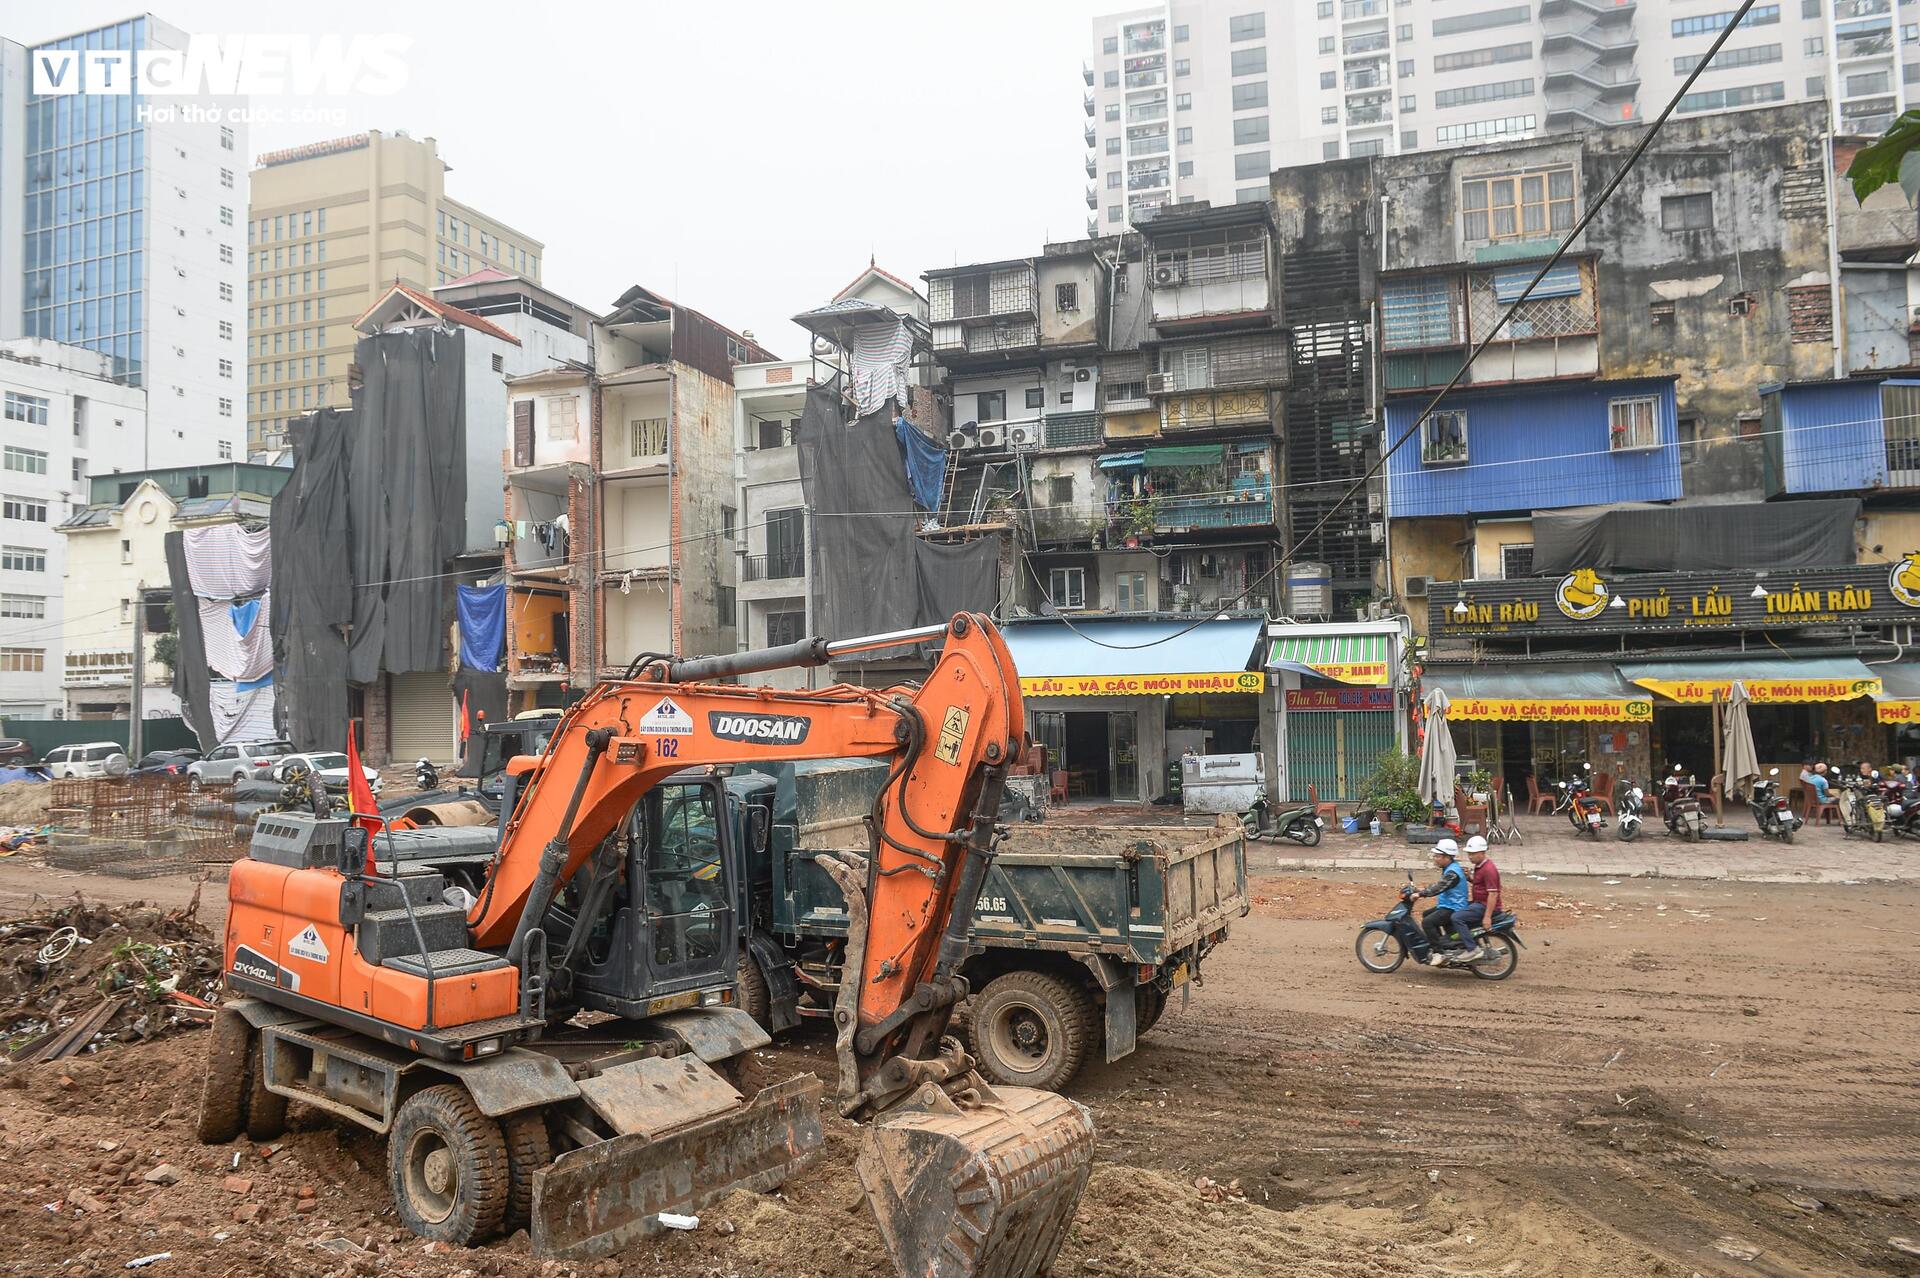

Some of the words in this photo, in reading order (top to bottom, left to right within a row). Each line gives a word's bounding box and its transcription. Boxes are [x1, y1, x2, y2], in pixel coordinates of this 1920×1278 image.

[1628, 587, 1671, 618] PHỞ
[1691, 584, 1733, 617] LẨU
[1764, 582, 1821, 614] TUẤN
[1827, 584, 1872, 612] RÂU
[1500, 597, 1539, 623] RÂU
[1351, 665, 1371, 676] NAM
[1032, 679, 1063, 692] LẨU
[1078, 679, 1100, 691] VÀ
[1105, 677, 1139, 691] CÁC
[1143, 677, 1182, 690] MÓN
[1187, 676, 1235, 690] NHẬU
[1240, 675, 1258, 687] 643
[1287, 691, 1310, 705] Thu
[1314, 691, 1337, 705] Thu
[1676, 683, 1703, 697] LẨU
[1770, 684, 1803, 697] MÓN
[1807, 685, 1847, 698] NHẬU
[1463, 701, 1489, 715] LẨU
[1500, 702, 1518, 715] VÀ
[1520, 702, 1547, 715] CÁC
[1551, 702, 1580, 715] MÓN
[1583, 703, 1620, 718] NHẬU
[1629, 703, 1648, 714] 643
[1879, 705, 1910, 719] PHỞ
[716, 716, 803, 740] DOOSAN
[655, 738, 679, 758] 162
[975, 897, 1007, 911] 56.65
